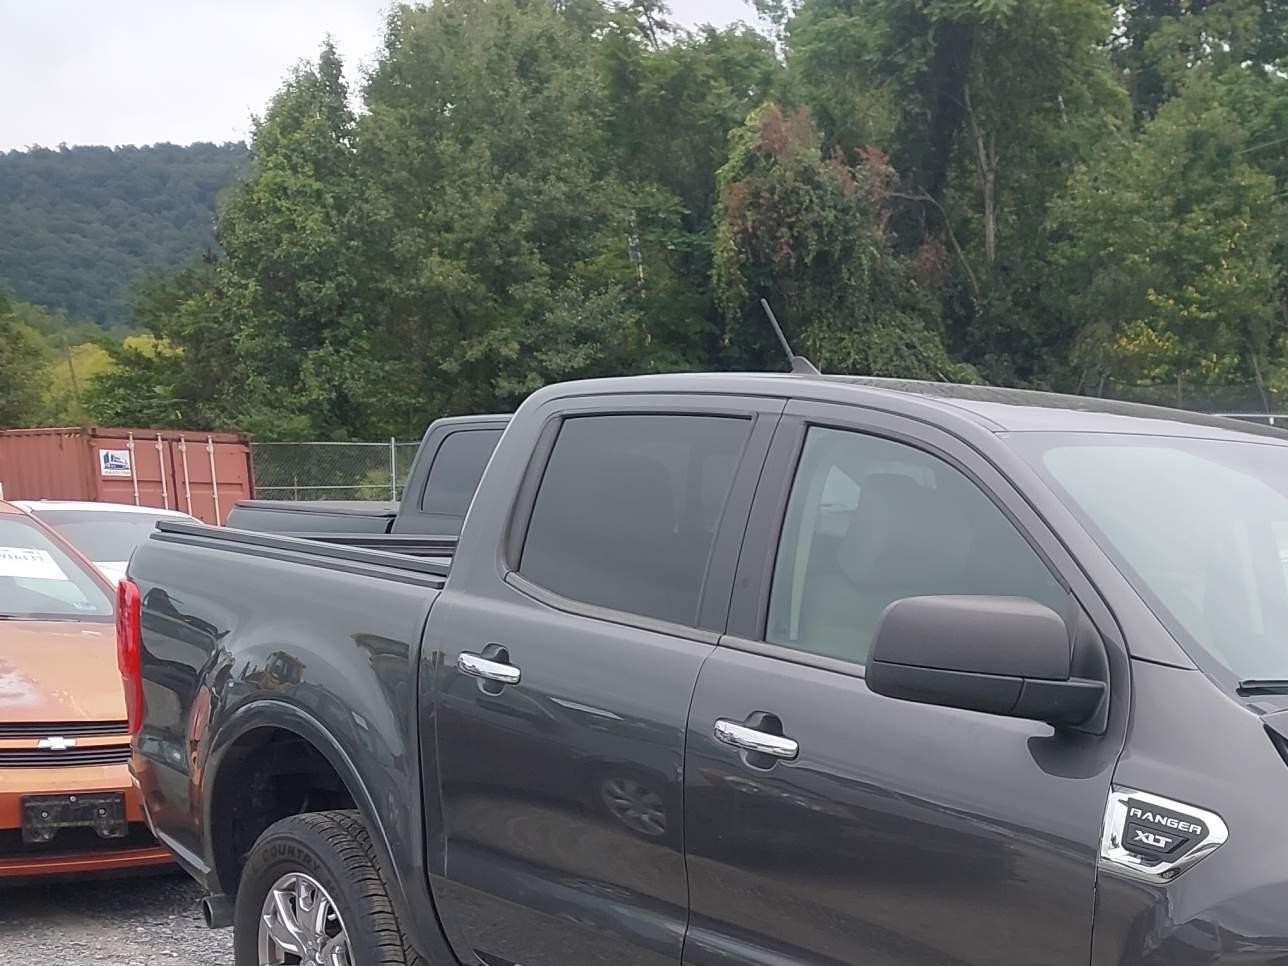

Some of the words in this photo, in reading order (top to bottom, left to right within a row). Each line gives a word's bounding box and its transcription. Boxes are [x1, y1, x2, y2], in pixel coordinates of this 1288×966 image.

[1129, 807, 1202, 835] RANGER
[1134, 829, 1173, 848] XLT
[263, 843, 321, 871] COUNTRY
